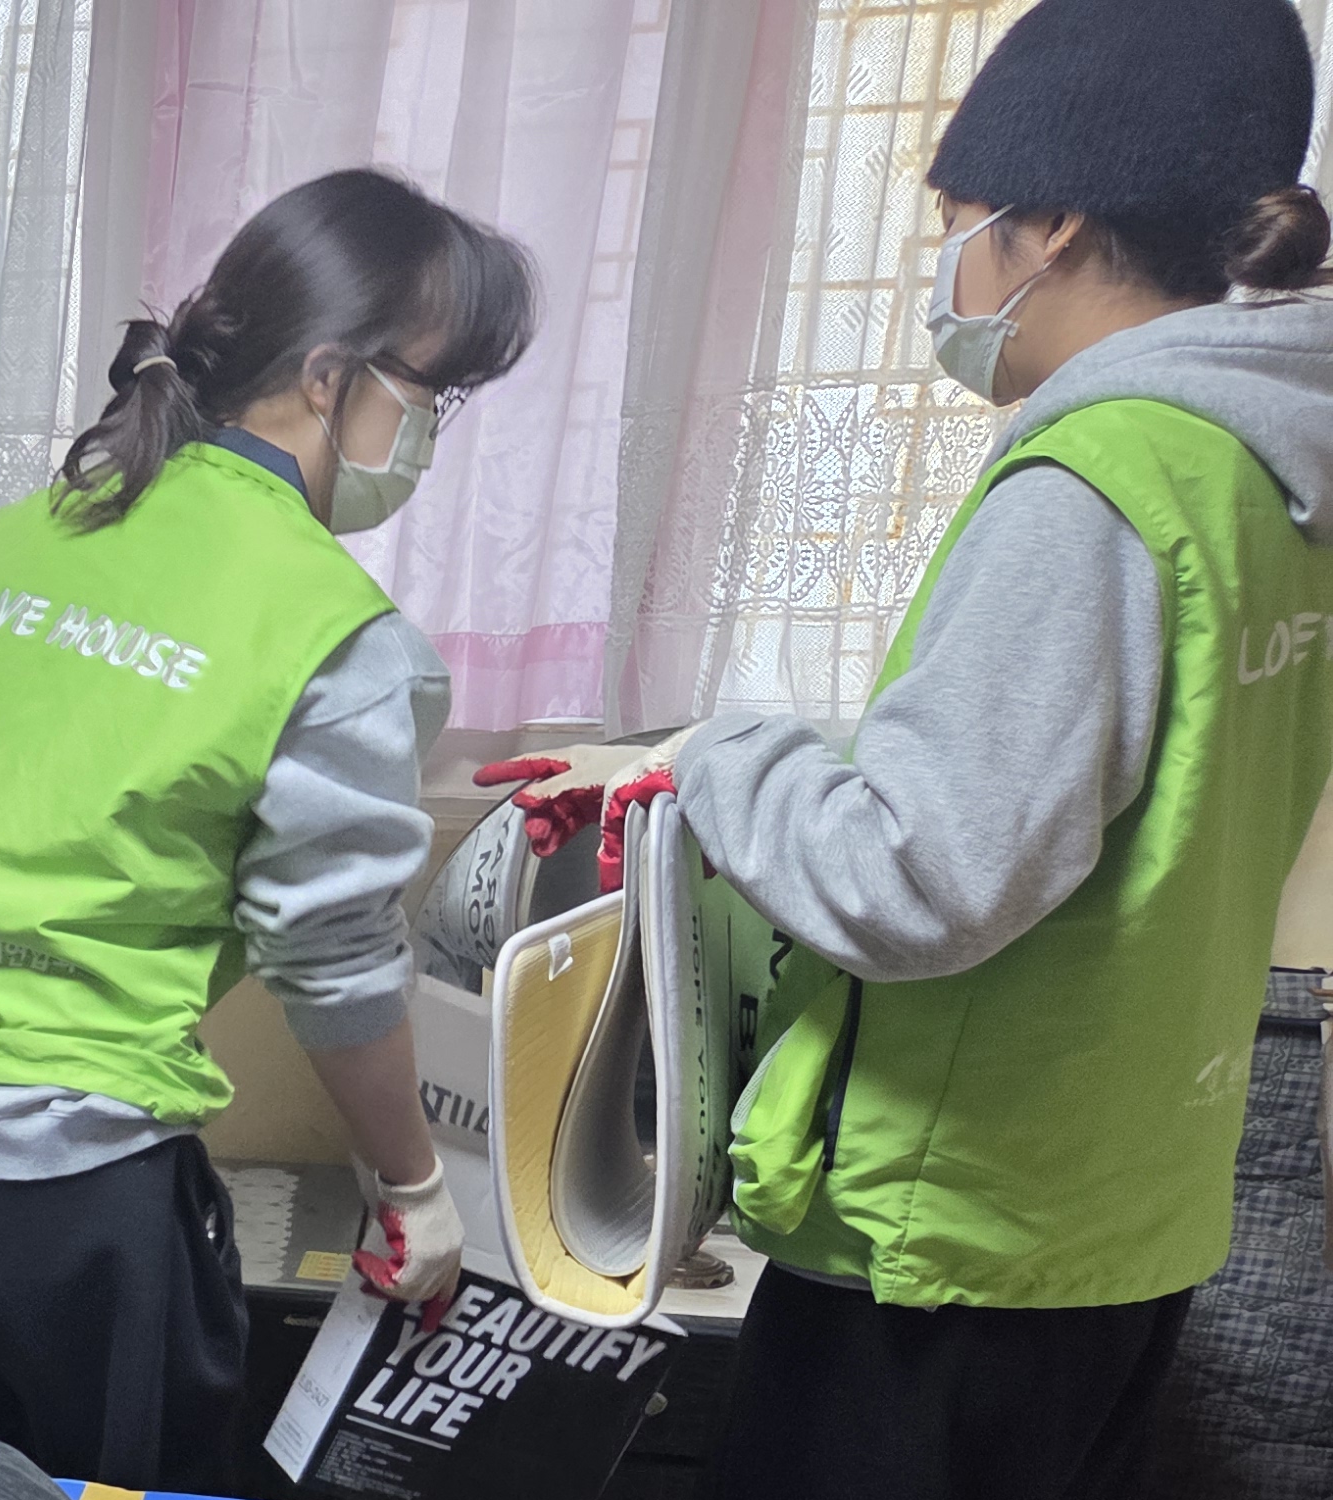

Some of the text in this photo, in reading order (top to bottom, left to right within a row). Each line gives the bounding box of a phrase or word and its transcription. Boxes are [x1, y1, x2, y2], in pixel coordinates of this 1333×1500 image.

[44, 603, 207, 689] HOUSE
[385, 1318, 532, 1401] YOUR
[353, 1367, 484, 1439] LIFE
